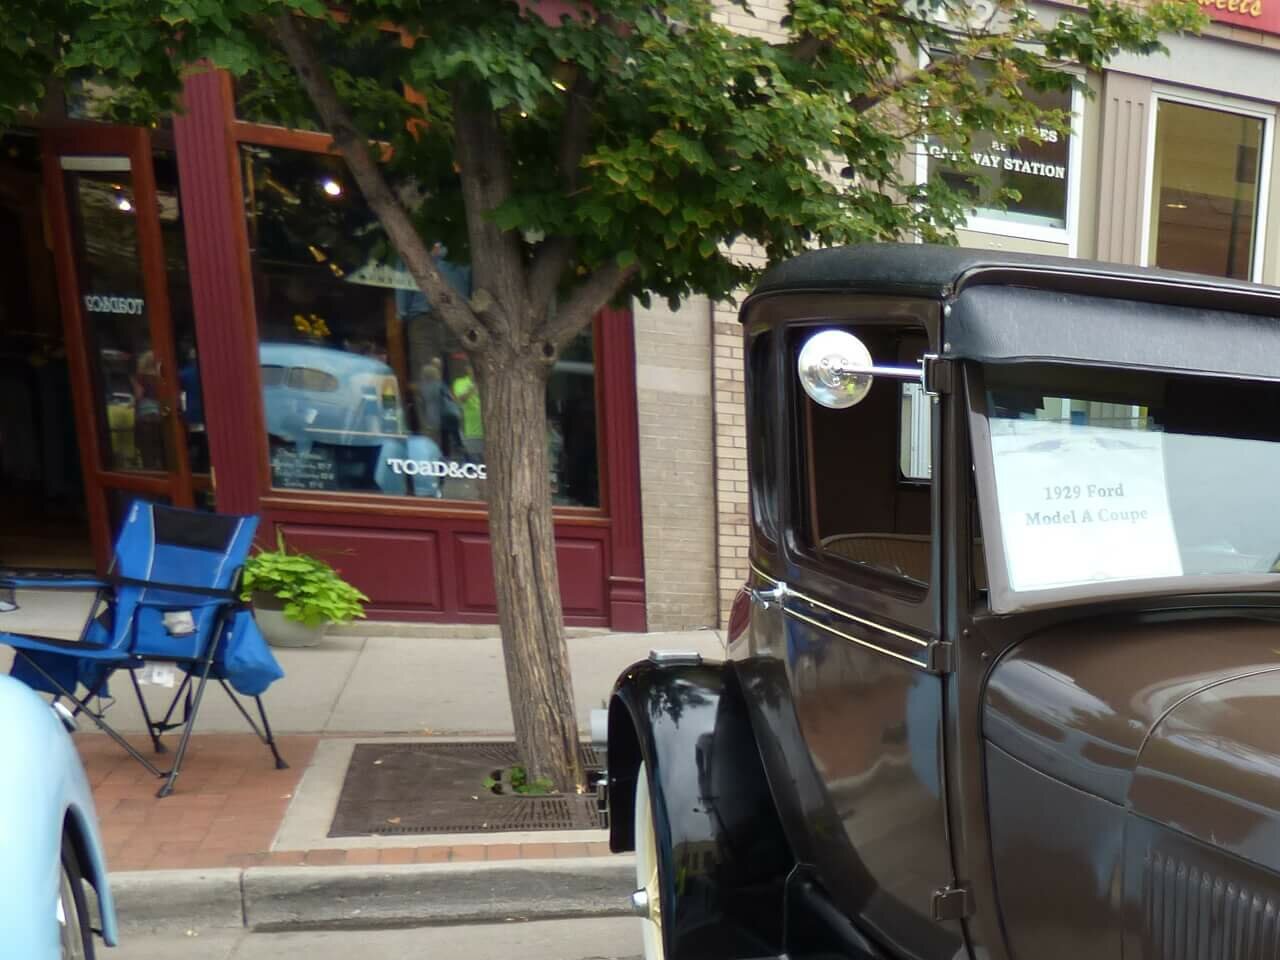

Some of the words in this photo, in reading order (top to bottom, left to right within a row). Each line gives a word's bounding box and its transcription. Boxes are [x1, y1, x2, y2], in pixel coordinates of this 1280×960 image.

[1197, 0, 1263, 17] eets
[1003, 157, 1066, 179] STATION
[1043, 485, 1082, 500] 1929
[1087, 483, 1125, 498] Ford
[1025, 509, 1077, 526] Model
[1080, 508, 1095, 523] A
[1097, 507, 1149, 524] Coupe
